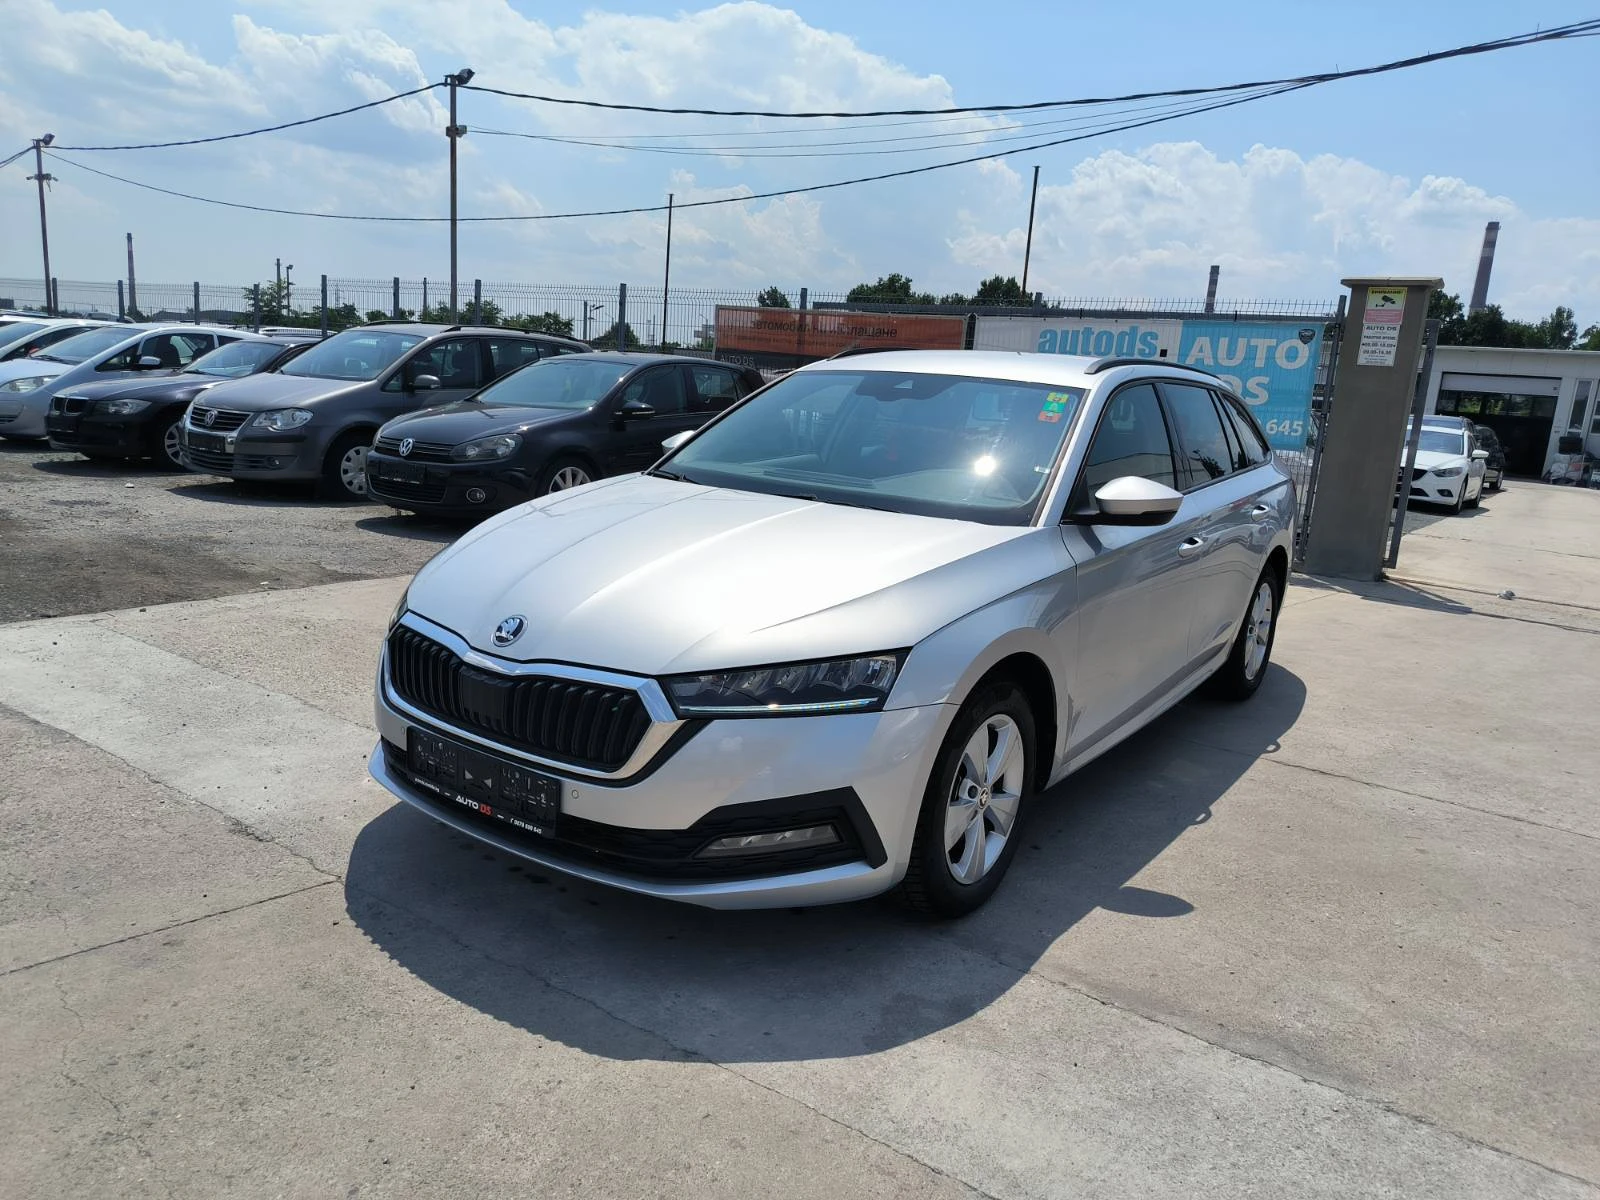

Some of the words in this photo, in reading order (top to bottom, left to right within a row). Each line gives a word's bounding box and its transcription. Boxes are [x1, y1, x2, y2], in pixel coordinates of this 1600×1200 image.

[1038, 326, 1158, 358] autods
[1186, 336, 1310, 370] AUTO
[1265, 419, 1304, 436] 645
[455, 795, 479, 810] AUTO
[480, 803, 492, 816] DS
